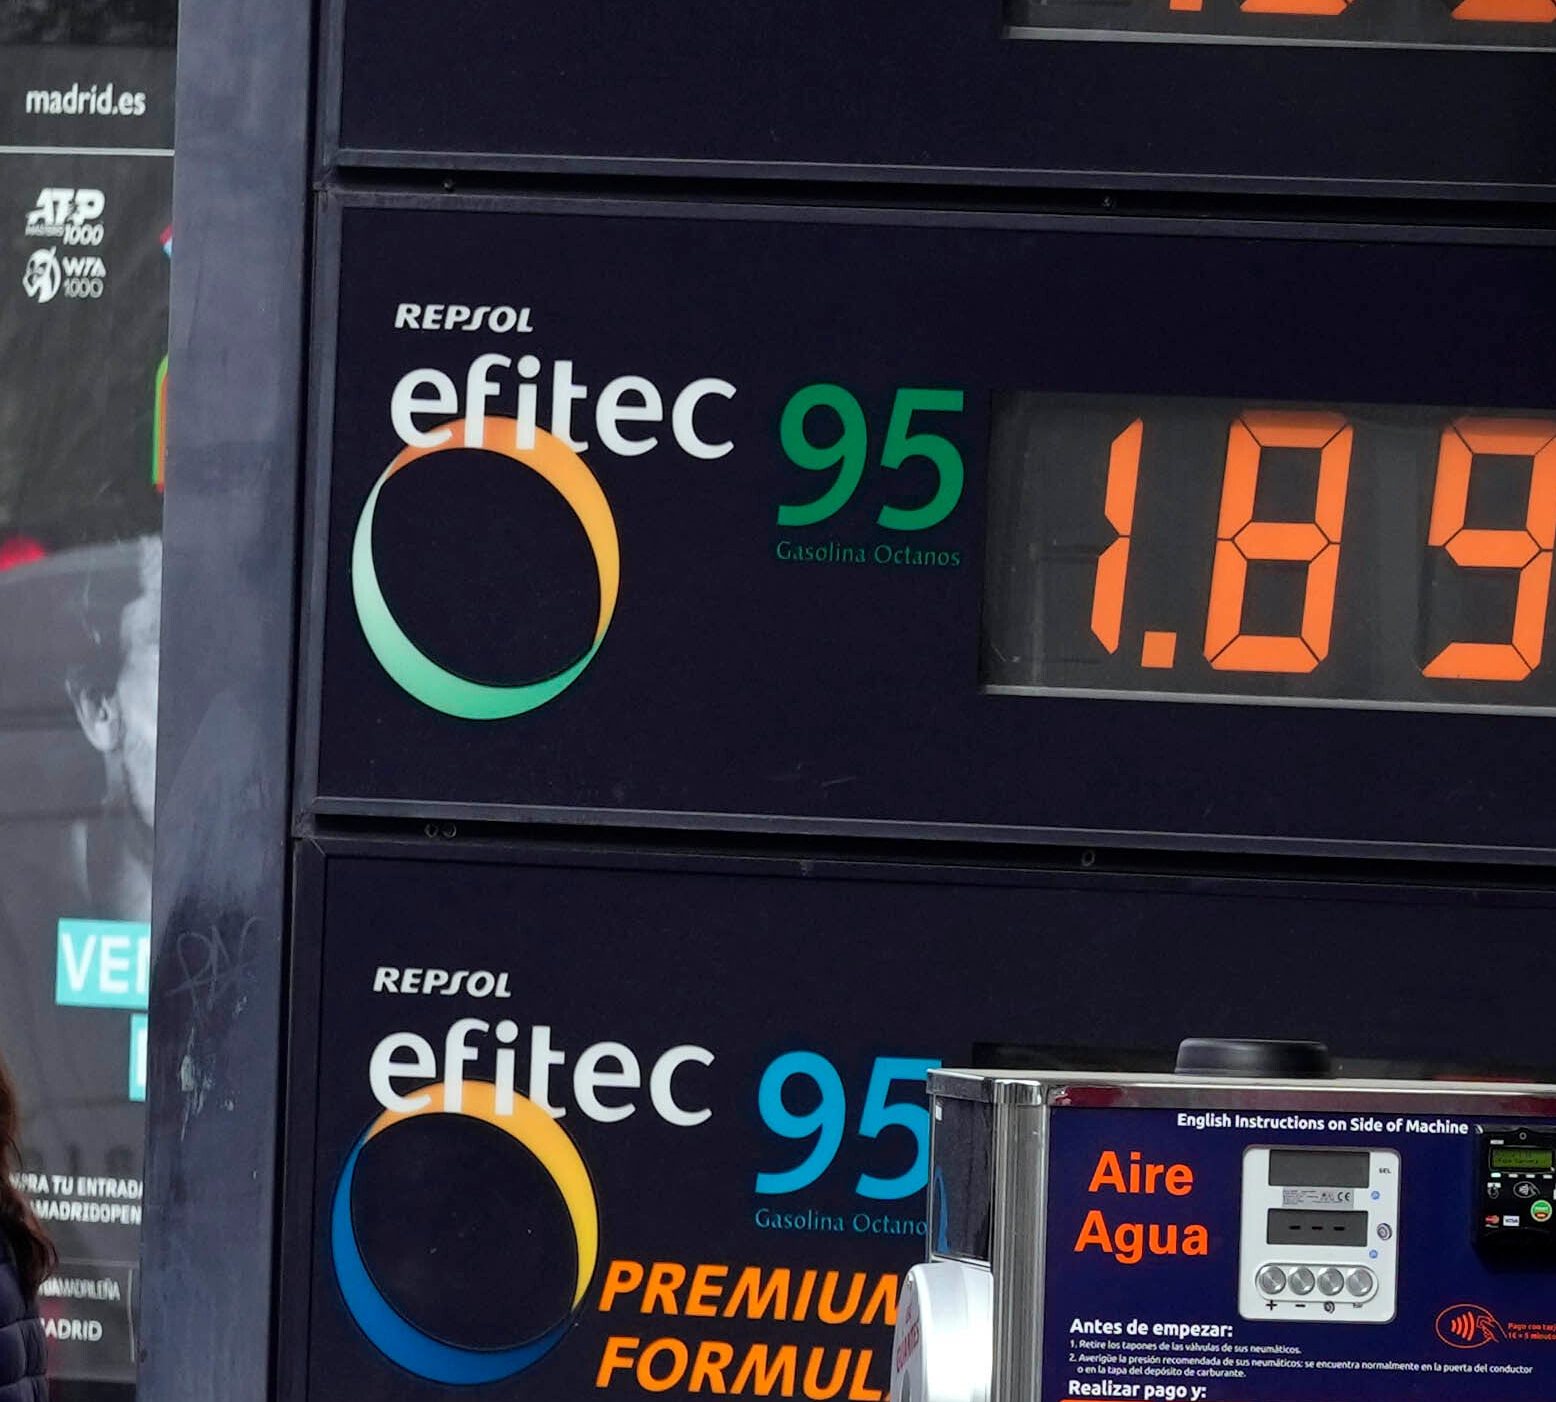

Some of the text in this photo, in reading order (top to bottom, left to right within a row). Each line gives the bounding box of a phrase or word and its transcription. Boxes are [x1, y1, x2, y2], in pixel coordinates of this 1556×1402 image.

[26, 82, 146, 116] madrid.es
[26, 187, 105, 226] ATP
[63, 224, 104, 246] 1000
[62, 256, 106, 277] WTA
[63, 277, 104, 298] 1000
[394, 303, 534, 333] REPSOL
[391, 353, 964, 531] efitec 95
[776, 540, 961, 567] Gasolina Octanos
[373, 966, 512, 998] REPSOL
[369, 1017, 716, 1127] efitec
[1177, 1113, 1468, 1134] English Instructions on Side of Machine
[51, 1174, 74, 1196] TU
[1088, 1150, 1194, 1196] Aire
[755, 1207, 927, 1237] Gasolina Octano
[1073, 1209, 1208, 1265] Agua
[1070, 1318, 1233, 1340] Antes de empezar:
[1079, 1340, 1107, 1350] Retire
[1107, 1340, 1121, 1350] los
[1122, 1341, 1157, 1352] tapones
[1159, 1341, 1170, 1351] de
[1171, 1342, 1184, 1351] las
[1221, 1343, 1233, 1352] de
[1234, 1345, 1248, 1353] sus
[595, 1336, 892, 1402] FORMUL
[1069, 1353, 1077, 1362] 2.
[1119, 1354, 1127, 1363] la
[1128, 1355, 1161, 1366] presión
[1162, 1355, 1221, 1366] recomendada
[1223, 1357, 1234, 1366] de
[1235, 1358, 1250, 1367] sus
[1305, 1360, 1315, 1368] se
[1316, 1360, 1360, 1370] encuentra
[1362, 1361, 1420, 1371] normalmente
[1421, 1363, 1432, 1372] en
[1434, 1362, 1442, 1371] la
[1443, 1363, 1472, 1373] puerta
[1474, 1363, 1488, 1373] del
[1489, 1364, 1533, 1374] conductor
[1098, 1365, 1107, 1374] la
[1108, 1367, 1127, 1376] tapa
[1129, 1366, 1142, 1375] del
[1144, 1367, 1182, 1377] depósito
[1184, 1368, 1195, 1376] de
[1196, 1368, 1246, 1378] carburante.
[1069, 1380, 1207, 1401] Realizar pago y:
